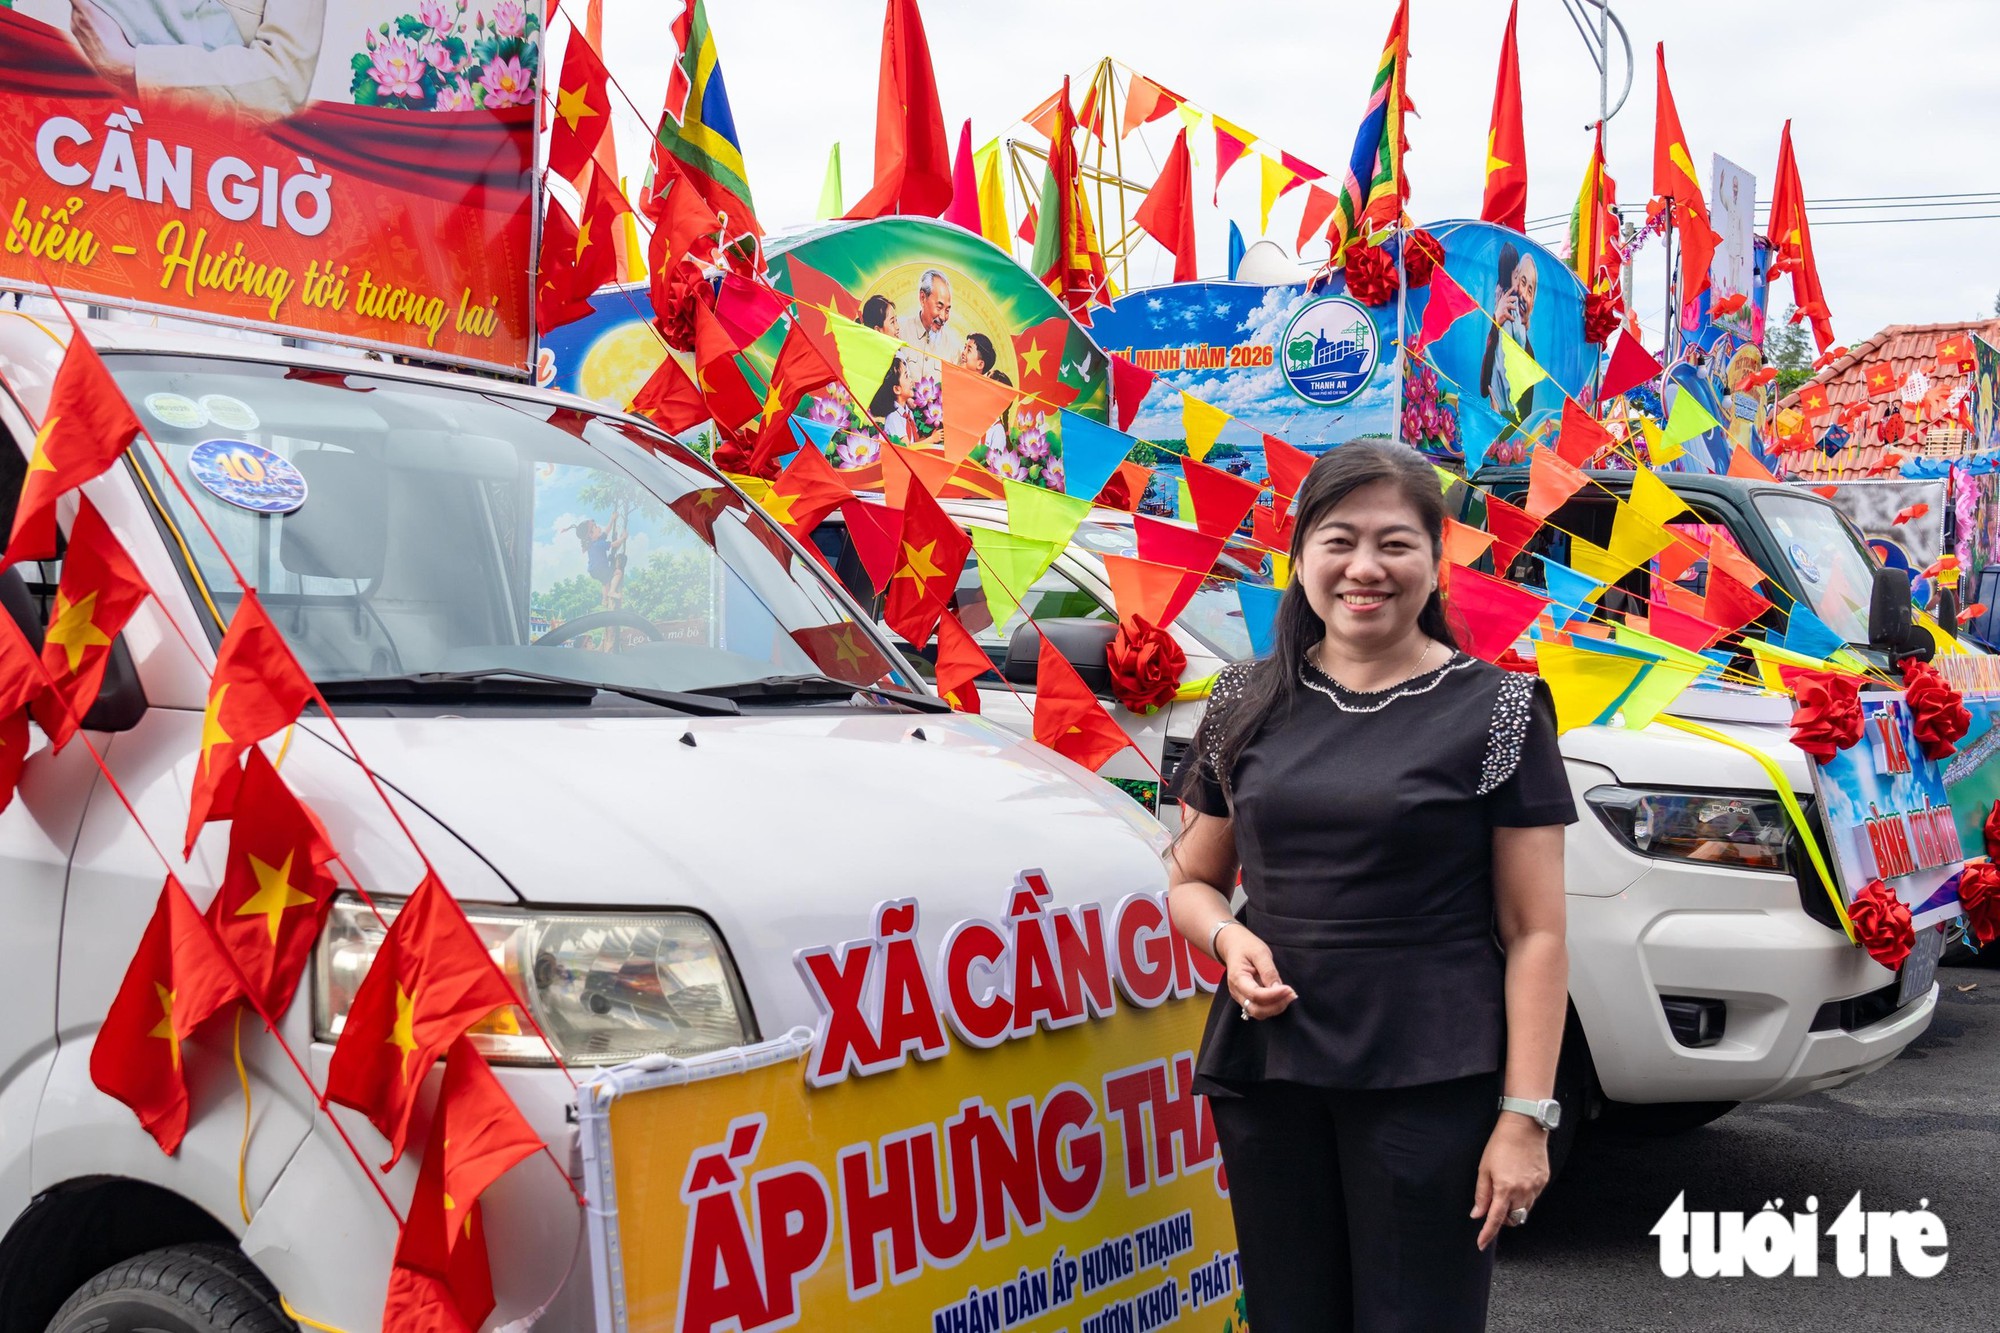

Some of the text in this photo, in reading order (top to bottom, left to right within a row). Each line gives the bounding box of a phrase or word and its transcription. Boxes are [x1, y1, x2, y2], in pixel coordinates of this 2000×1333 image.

[36, 106, 332, 236] CẦN GIỜ
[4, 197, 100, 266] biển
[156, 219, 295, 320] Hướng
[302, 260, 349, 311] tới
[356, 271, 450, 347] tương
[456, 286, 498, 338] lai
[1136, 347, 1180, 371] MINH
[1185, 343, 1226, 370] NĂM
[1231, 345, 1273, 368] 2026
[1311, 380, 1347, 391] THẠNH AN
[215, 447, 266, 482] 10
[1874, 700, 1911, 774] XÃ
[1865, 793, 1963, 881] BÌNH KHÁNH
[802, 873, 1226, 1079] XÃ CẦN GI
[681, 1122, 830, 1333] ẤP
[843, 1089, 1102, 1291] HƯNG
[1003, 1271, 1047, 1325] DÂN
[1052, 1248, 1077, 1305] ẤP
[1081, 1241, 1133, 1292] HƯNG
[1135, 1213, 1193, 1267] THẠNH
[1137, 1280, 1178, 1332] KHƠI
[1190, 1253, 1231, 1307] PHÁT
